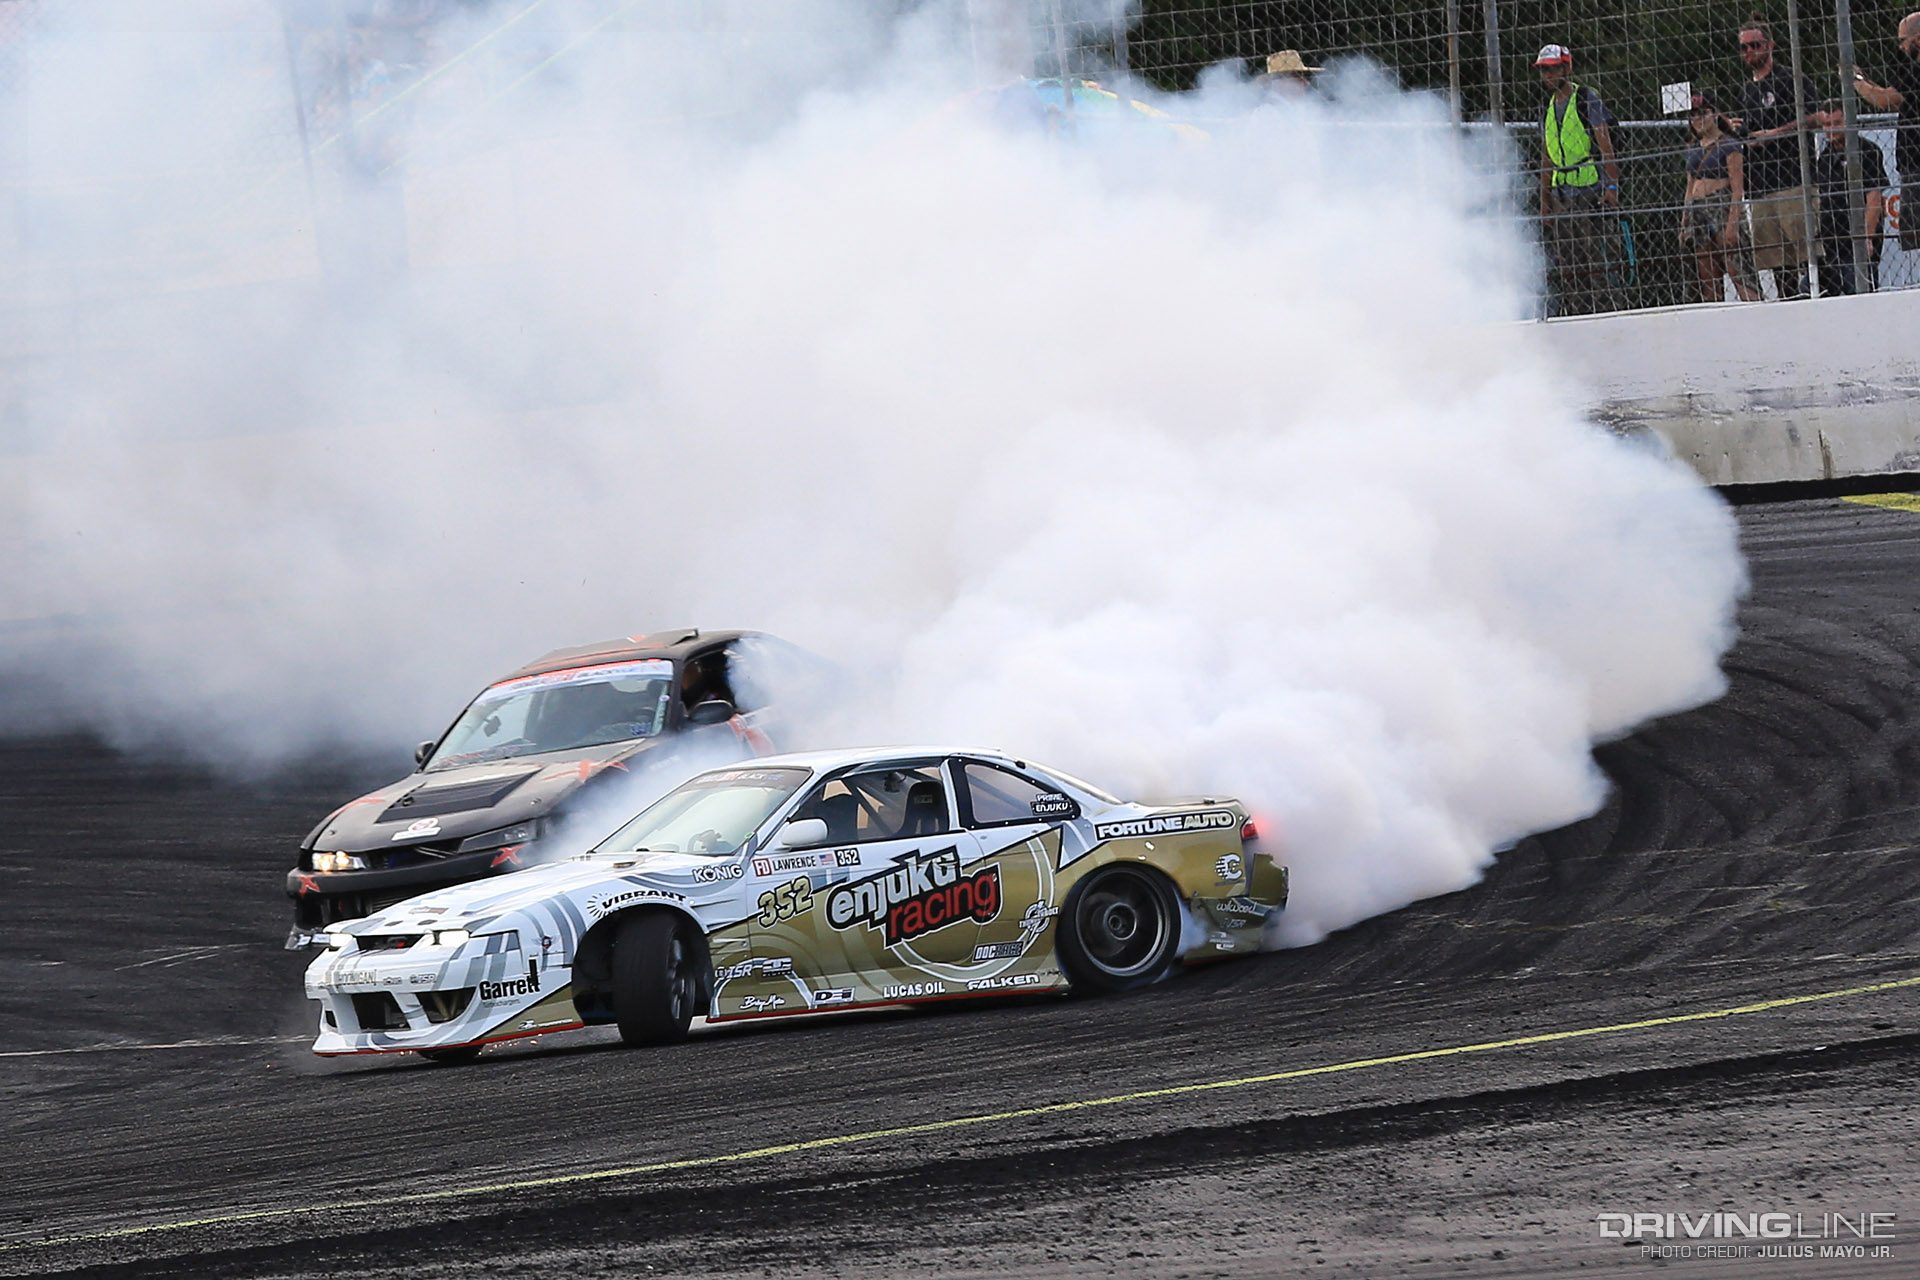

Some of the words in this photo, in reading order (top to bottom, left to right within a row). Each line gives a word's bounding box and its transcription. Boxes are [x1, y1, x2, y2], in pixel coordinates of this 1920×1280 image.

[1098, 816, 1183, 838] FORTUNE
[1183, 812, 1232, 829] AUTO
[772, 856, 817, 871] LAWRENCE
[837, 849, 859, 865] 352
[601, 889, 687, 909] VIBRANT
[831, 852, 956, 923] enjuku
[758, 874, 813, 928] 352
[889, 873, 998, 939] racing
[479, 958, 541, 1000] Garrett
[883, 984, 922, 998] LUCAS
[925, 982, 946, 995] OIL
[967, 974, 1040, 991] FALKEN
